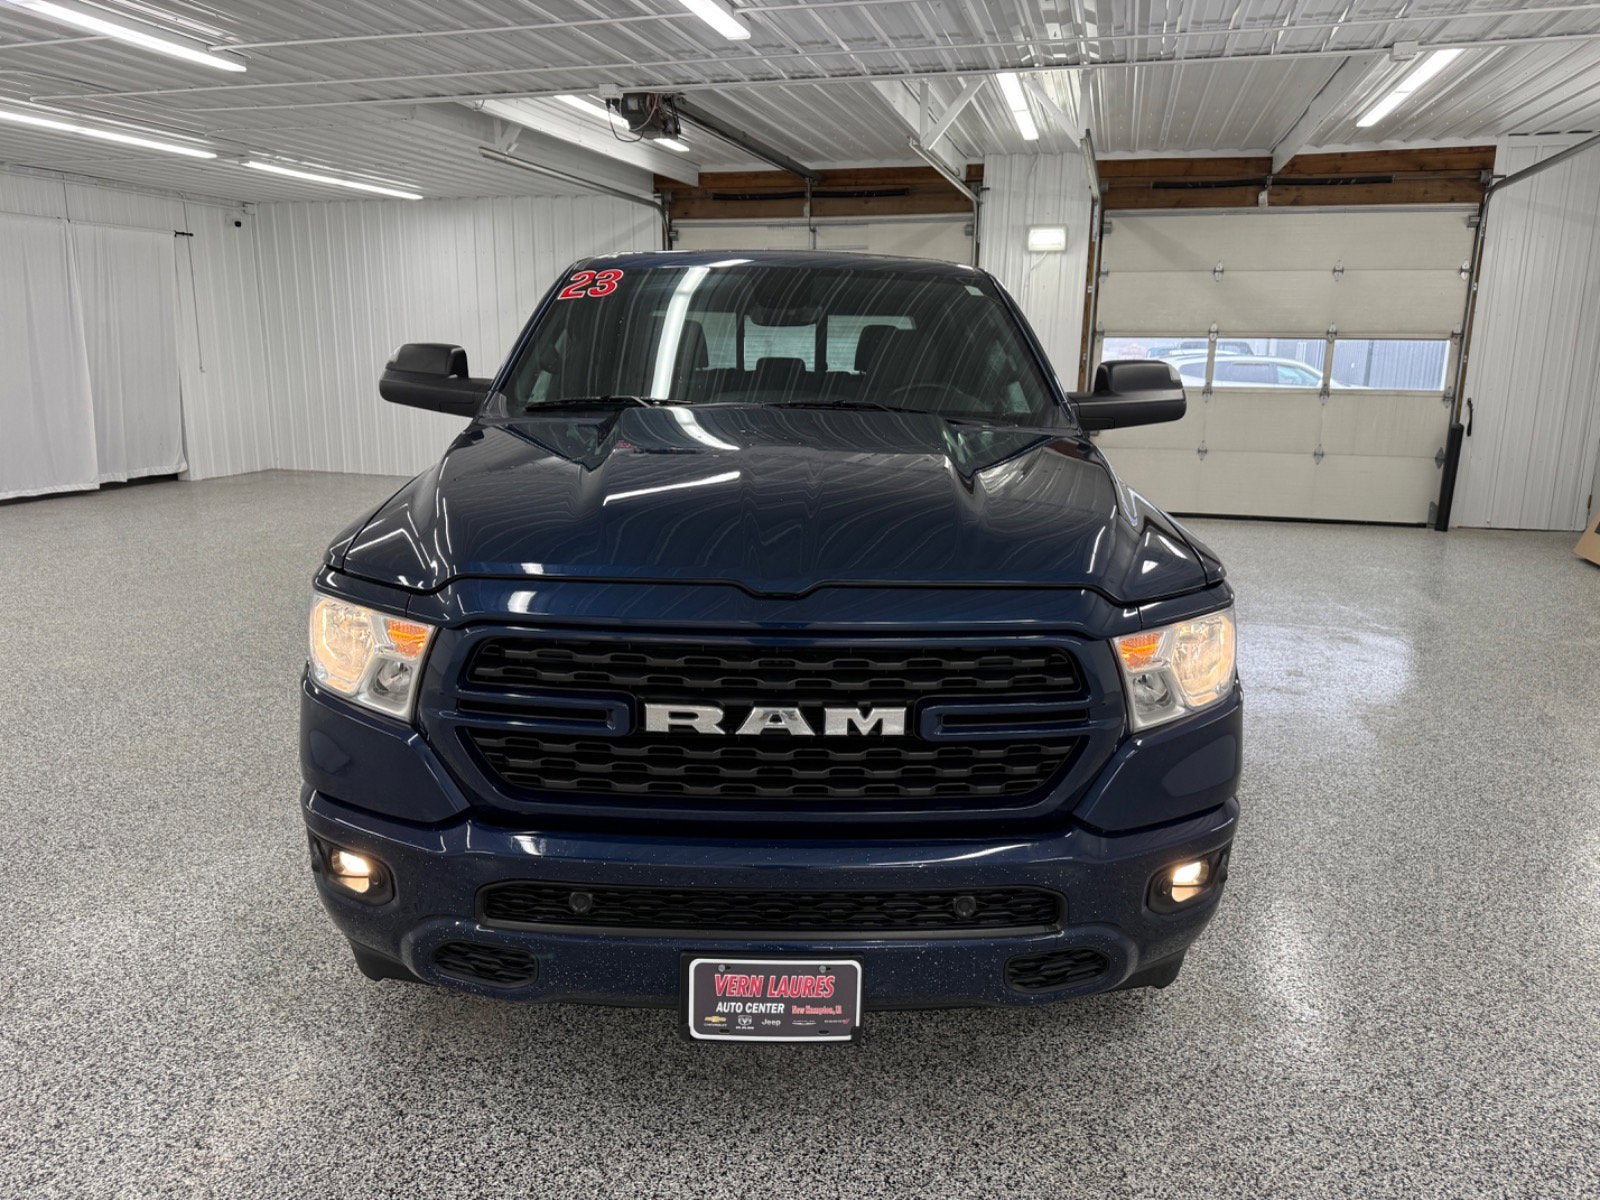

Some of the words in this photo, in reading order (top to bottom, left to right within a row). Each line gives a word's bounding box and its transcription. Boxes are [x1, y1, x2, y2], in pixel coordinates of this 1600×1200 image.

[558, 269, 624, 300] 23
[645, 703, 906, 736] RAM
[714, 974, 764, 998] VERN
[767, 975, 835, 998] LAURES
[716, 1001, 743, 1013] AUTO
[745, 1002, 785, 1014] CENTER
[761, 1018, 781, 1027] Jeep
